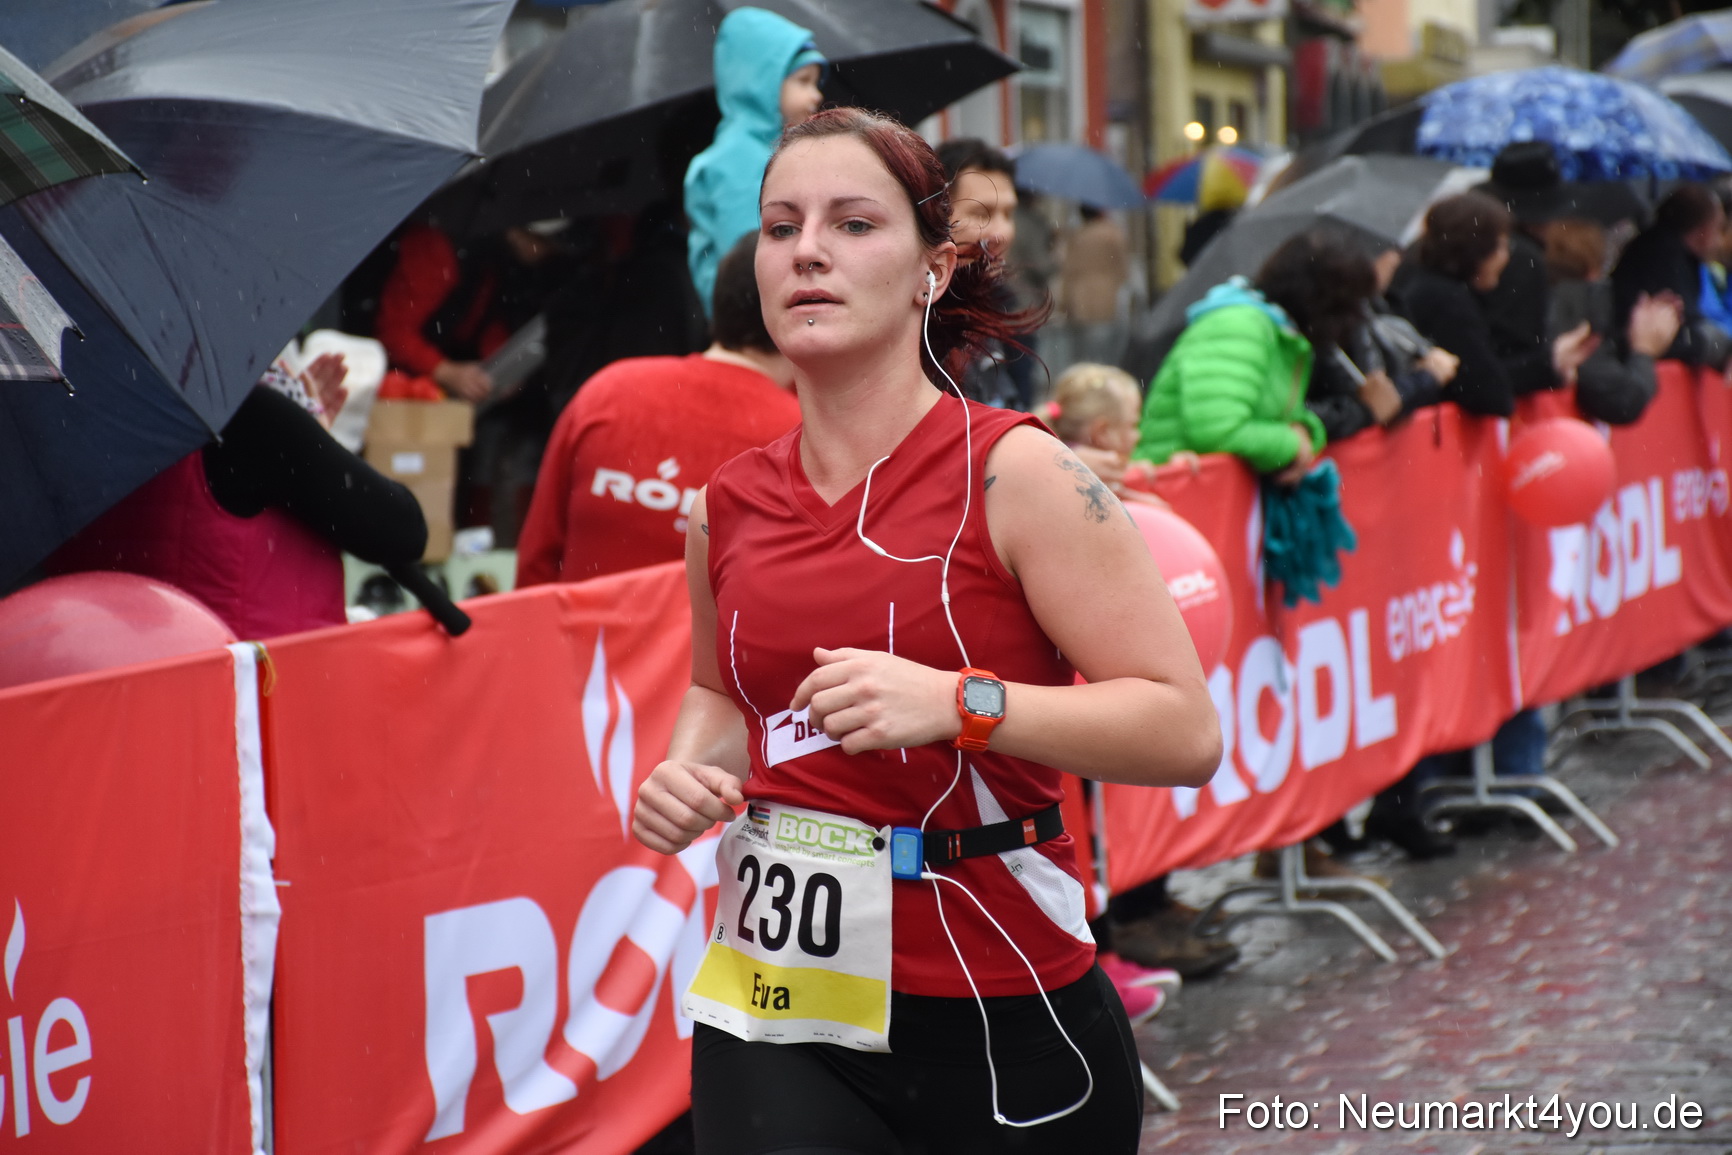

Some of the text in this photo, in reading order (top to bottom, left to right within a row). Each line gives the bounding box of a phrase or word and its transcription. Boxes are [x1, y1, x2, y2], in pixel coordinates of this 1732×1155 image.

[776, 813, 877, 857] BOCK
[812, 851, 836, 862] smart
[837, 855, 876, 868] concepts
[737, 854, 843, 958] 230
[717, 925, 725, 941] B
[751, 972, 790, 1011] Eva
